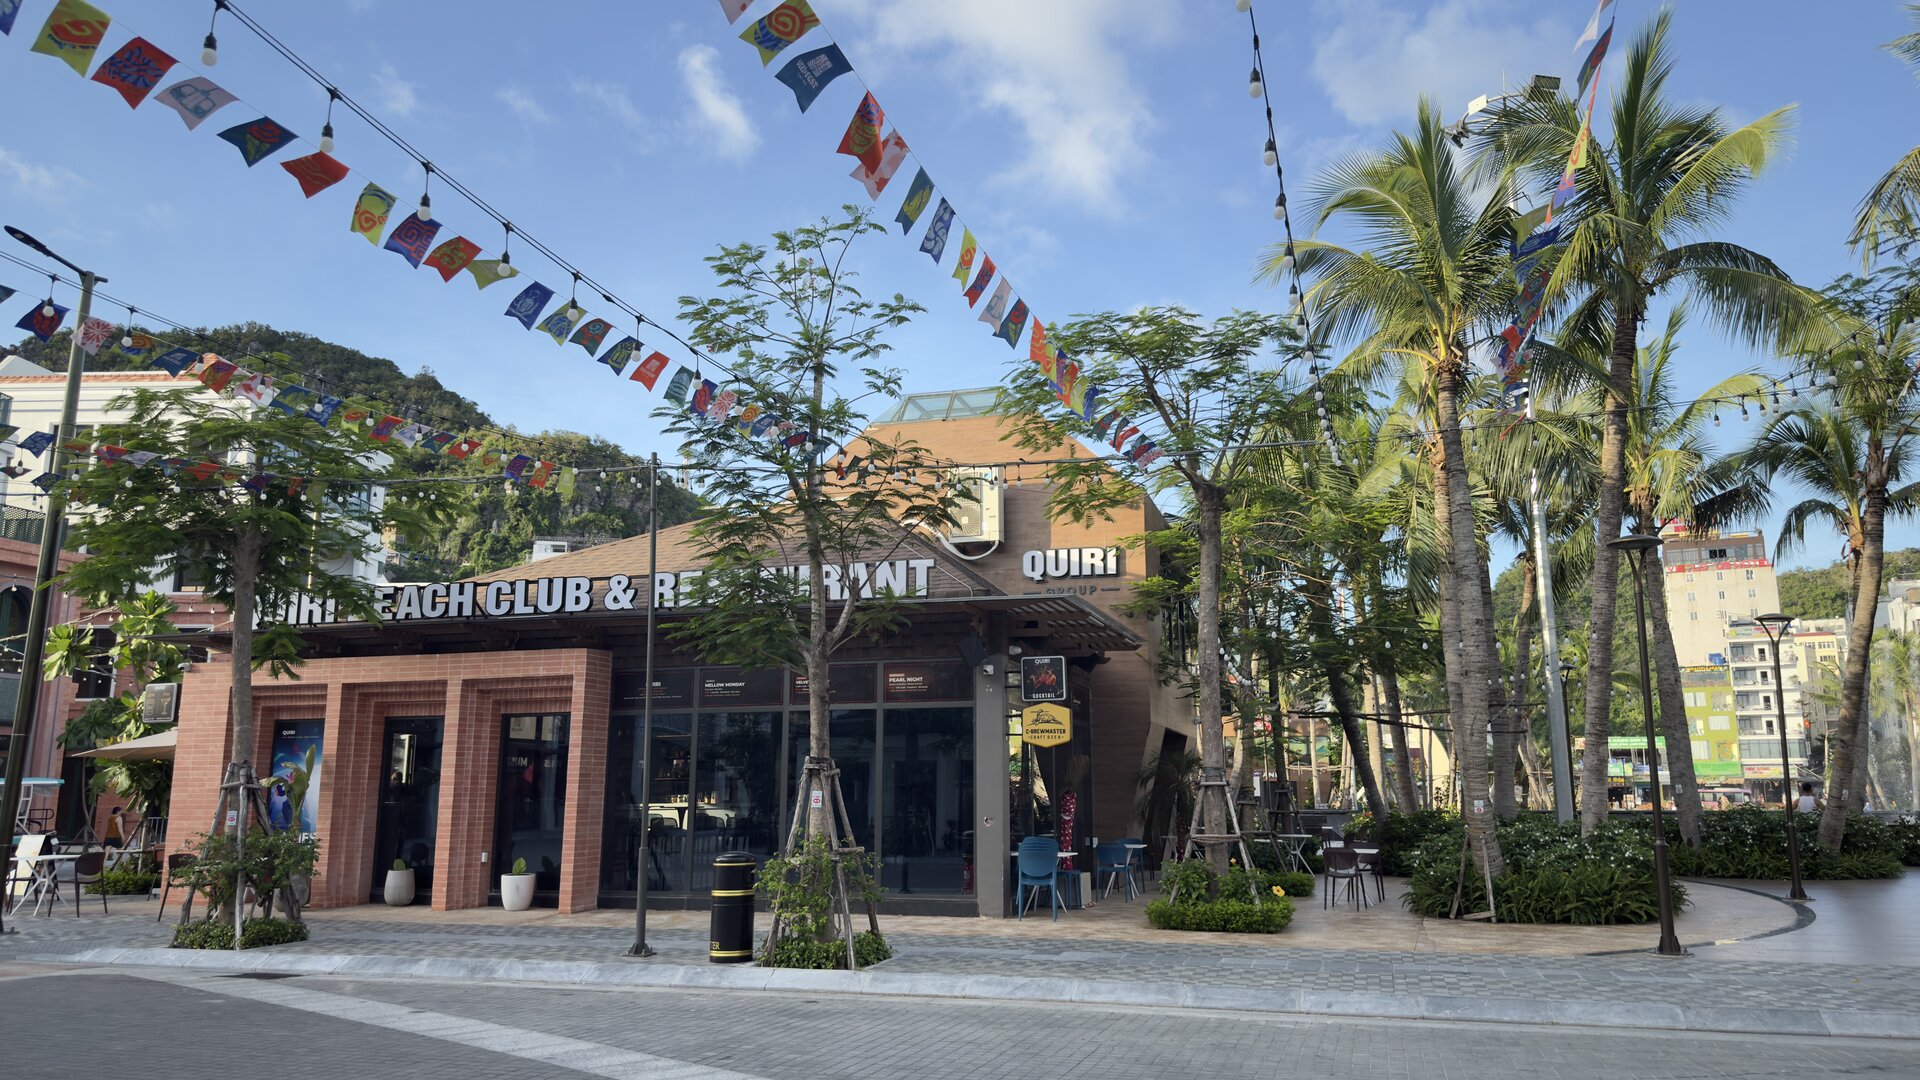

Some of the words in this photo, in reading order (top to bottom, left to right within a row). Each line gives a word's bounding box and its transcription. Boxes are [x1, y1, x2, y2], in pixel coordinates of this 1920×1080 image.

[1022, 547, 1118, 581] QUIRI
[347, 582, 475, 622] EACH
[485, 576, 592, 616] CLUB
[603, 574, 637, 611] &
[654, 558, 935, 609] REURANT
